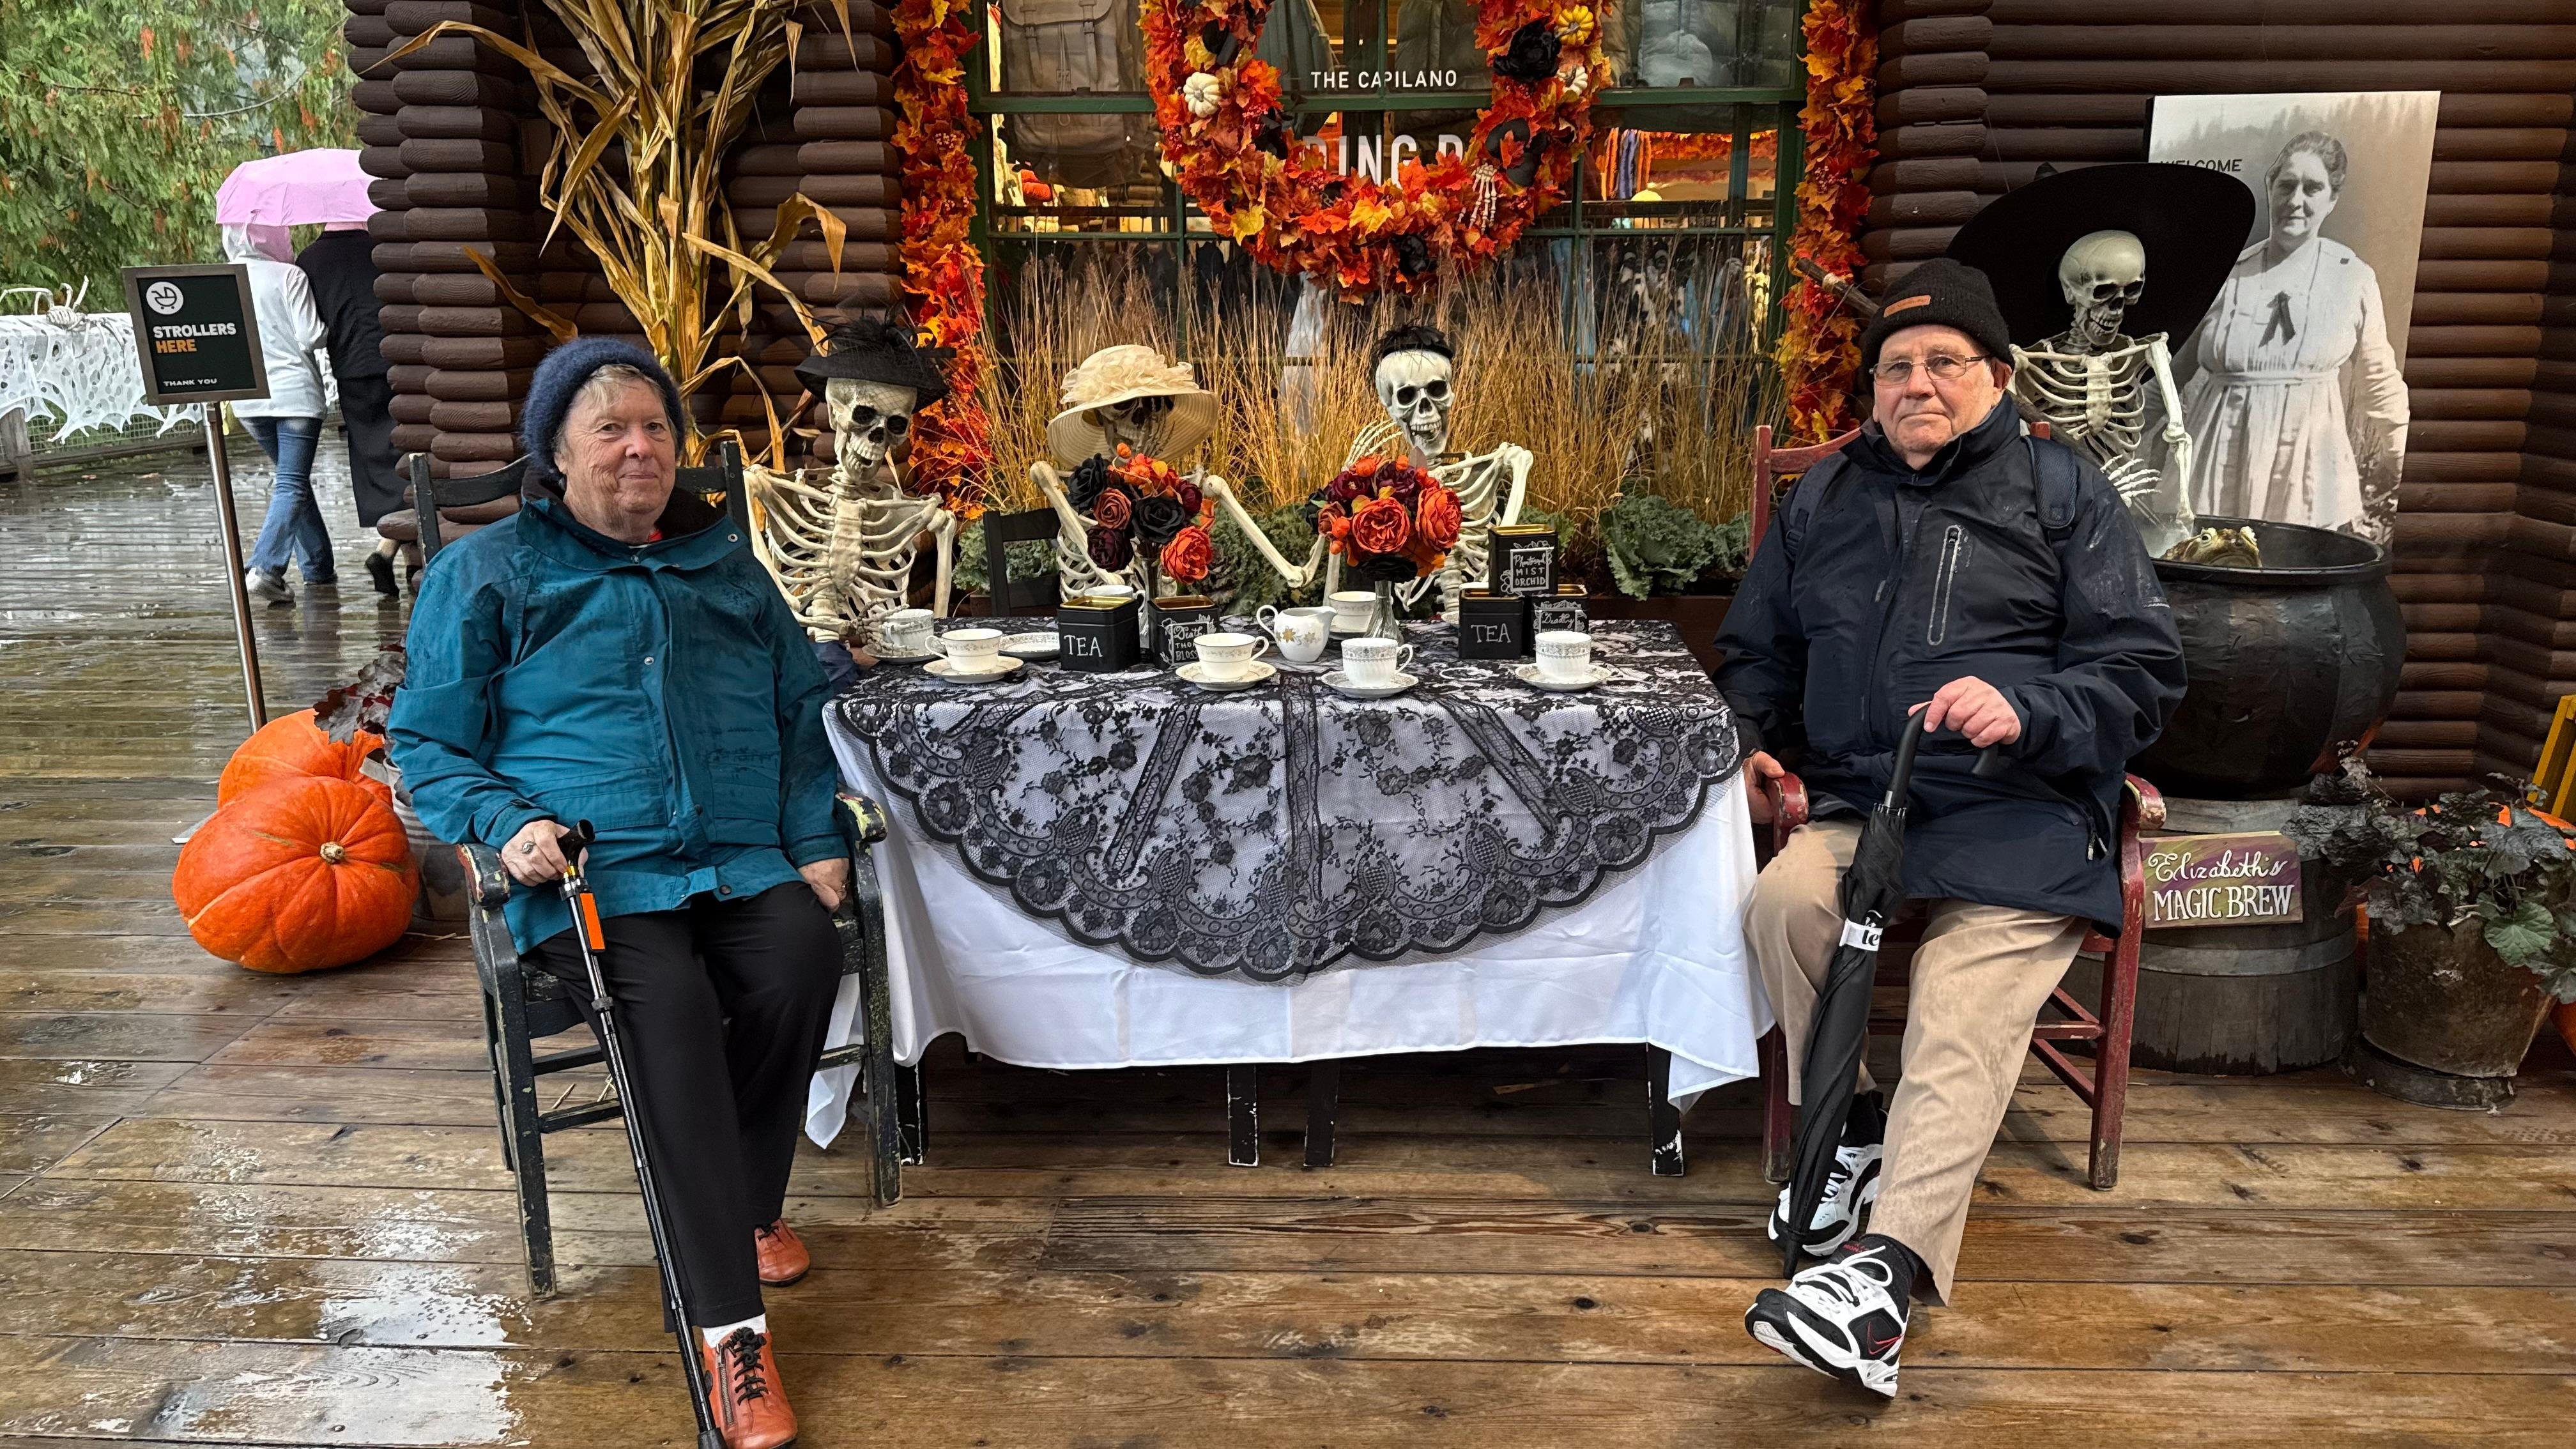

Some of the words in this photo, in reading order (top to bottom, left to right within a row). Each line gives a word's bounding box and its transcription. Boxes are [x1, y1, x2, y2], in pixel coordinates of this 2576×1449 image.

[1310, 71, 1349, 89] THE
[1358, 70, 1457, 88] CAPILANO
[153, 322, 237, 339] STROLLERS
[155, 339, 197, 353] HERE
[1515, 567, 1545, 576] MIST
[1515, 576, 1545, 586] ORCHID
[1471, 623, 1512, 643] TEA
[1064, 634, 1103, 657] TEA
[2148, 850, 2288, 882] Elizabeth's
[2152, 887, 2223, 922] MAGIC
[2225, 884, 2295, 918] BREW
